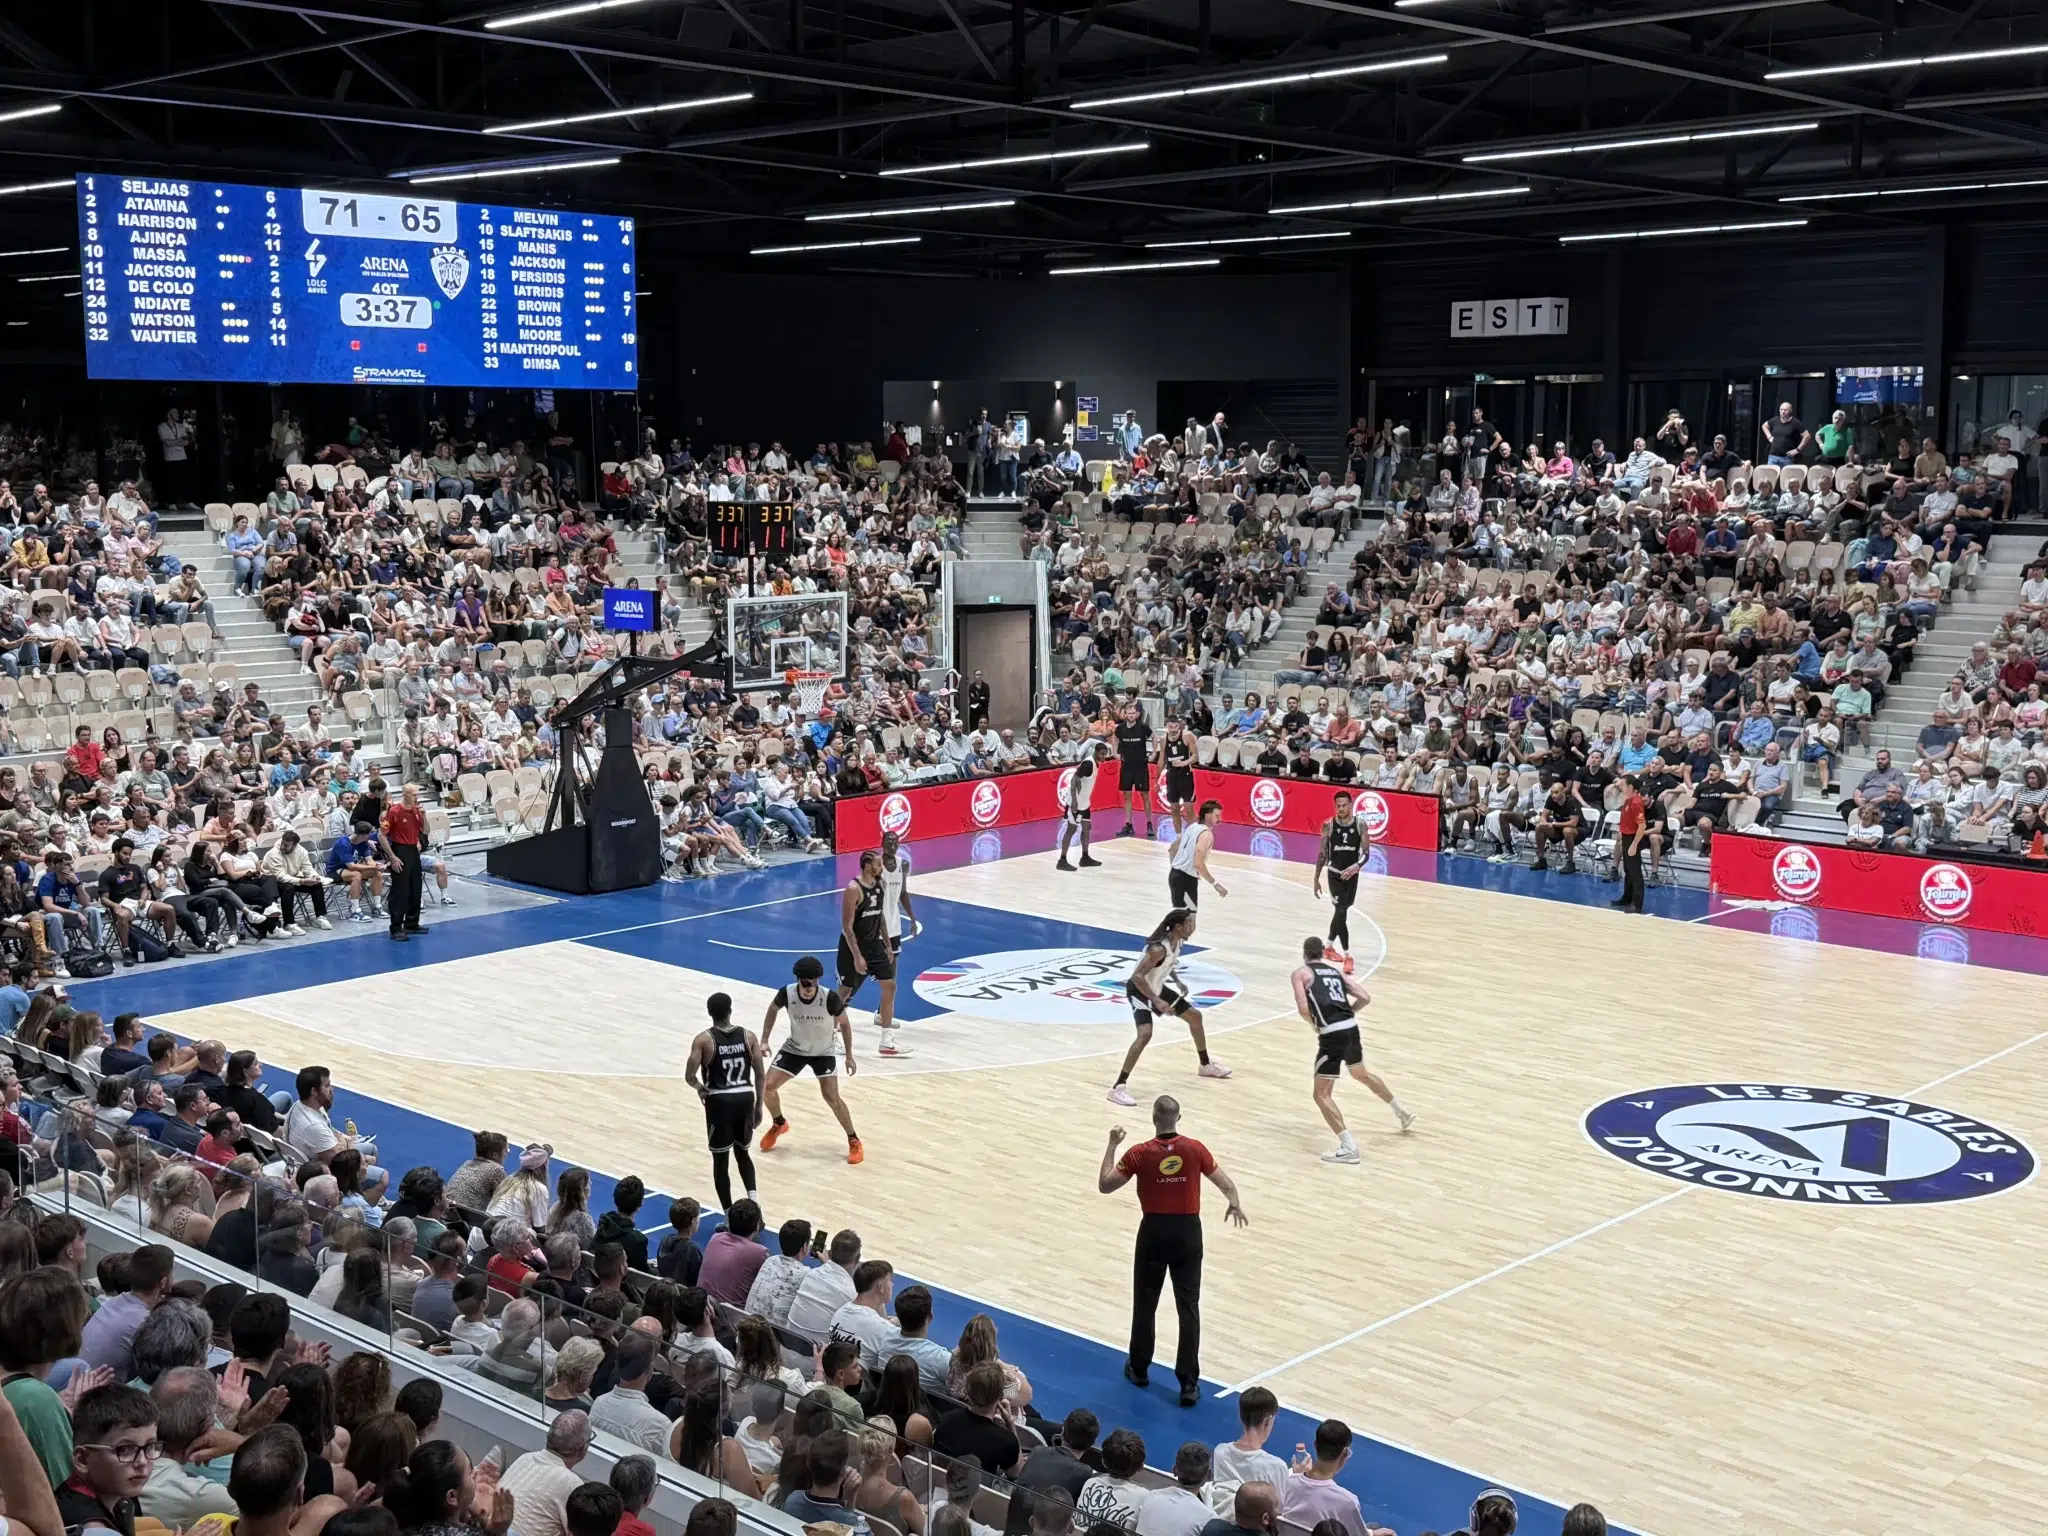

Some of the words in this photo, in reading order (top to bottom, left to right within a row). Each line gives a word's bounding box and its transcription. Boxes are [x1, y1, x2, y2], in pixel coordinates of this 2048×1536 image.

[84, 177, 94, 190] 1
[122, 180, 189, 197] SELJAAS
[265, 191, 276, 202] 6
[85, 195, 96, 208] 2
[125, 197, 188, 213] ATAMNA
[266, 208, 277, 219] 4
[319, 197, 358, 227] 71
[401, 204, 441, 233] 65
[86, 212, 97, 224] 3
[118, 213, 196, 230] HARRISON
[263, 223, 281, 235] 12
[480, 209, 489, 220] 2
[513, 211, 558, 226] MELVIN
[618, 220, 632, 232] 16
[87, 229, 98, 241] 8
[130, 230, 187, 247] AJINÇA
[264, 239, 281, 251] 11
[478, 223, 493, 235] 10
[500, 225, 572, 242] SLAFTSAKIS
[621, 235, 629, 245] 4
[84, 245, 104, 257] 10
[133, 247, 186, 262] MASSA
[269, 255, 279, 266] 2
[479, 239, 494, 250] 15
[518, 242, 556, 254] MANIS
[85, 262, 103, 274] 11
[123, 264, 196, 279] JACKSON
[270, 271, 280, 283] 2
[360, 256, 409, 273] ARENA
[480, 253, 495, 265] 16
[510, 256, 565, 270] JACKSON
[622, 263, 630, 274] 6
[480, 268, 495, 280] 18
[511, 270, 565, 284] PERSIDIS
[86, 279, 105, 291] 12
[128, 280, 149, 294] DE
[152, 281, 194, 295] COLO
[271, 287, 281, 299] 4
[371, 282, 399, 295] 4QT
[480, 283, 496, 294] 20
[513, 285, 564, 299] IATRIDIS
[623, 292, 631, 302] 5
[87, 296, 106, 308] 24
[134, 297, 191, 311] NDIAYE
[272, 303, 281, 315] 5
[355, 298, 417, 323] 3:37
[481, 298, 496, 309] 22
[518, 300, 561, 313] BROWN
[623, 306, 631, 316] 7
[87, 312, 107, 324] 30
[130, 313, 195, 327] WATSON
[269, 319, 287, 330] 14
[482, 313, 497, 324] 25
[518, 315, 562, 327] FILLIOS
[89, 329, 109, 341] 32
[131, 330, 197, 344] VAUTIER
[270, 334, 287, 347] 11
[482, 328, 498, 339] 26
[519, 329, 562, 342] MOORE
[621, 333, 635, 344] 19
[483, 342, 497, 353] 31
[500, 343, 581, 356] MANTHOPOUL
[484, 357, 499, 368] 33
[523, 358, 560, 370] DIMSA
[624, 361, 632, 372] 8
[613, 600, 644, 613] ARENA
[1342, 832, 1348, 843] 2
[1322, 977, 1346, 1002] 33
[722, 1057, 747, 1086] 22
[1705, 1085, 1813, 1101] LES
[1832, 1093, 2018, 1157] SABLES
[1604, 1135, 1893, 1203] D'OLONNE
[1692, 1143, 1823, 1177] ARENA
